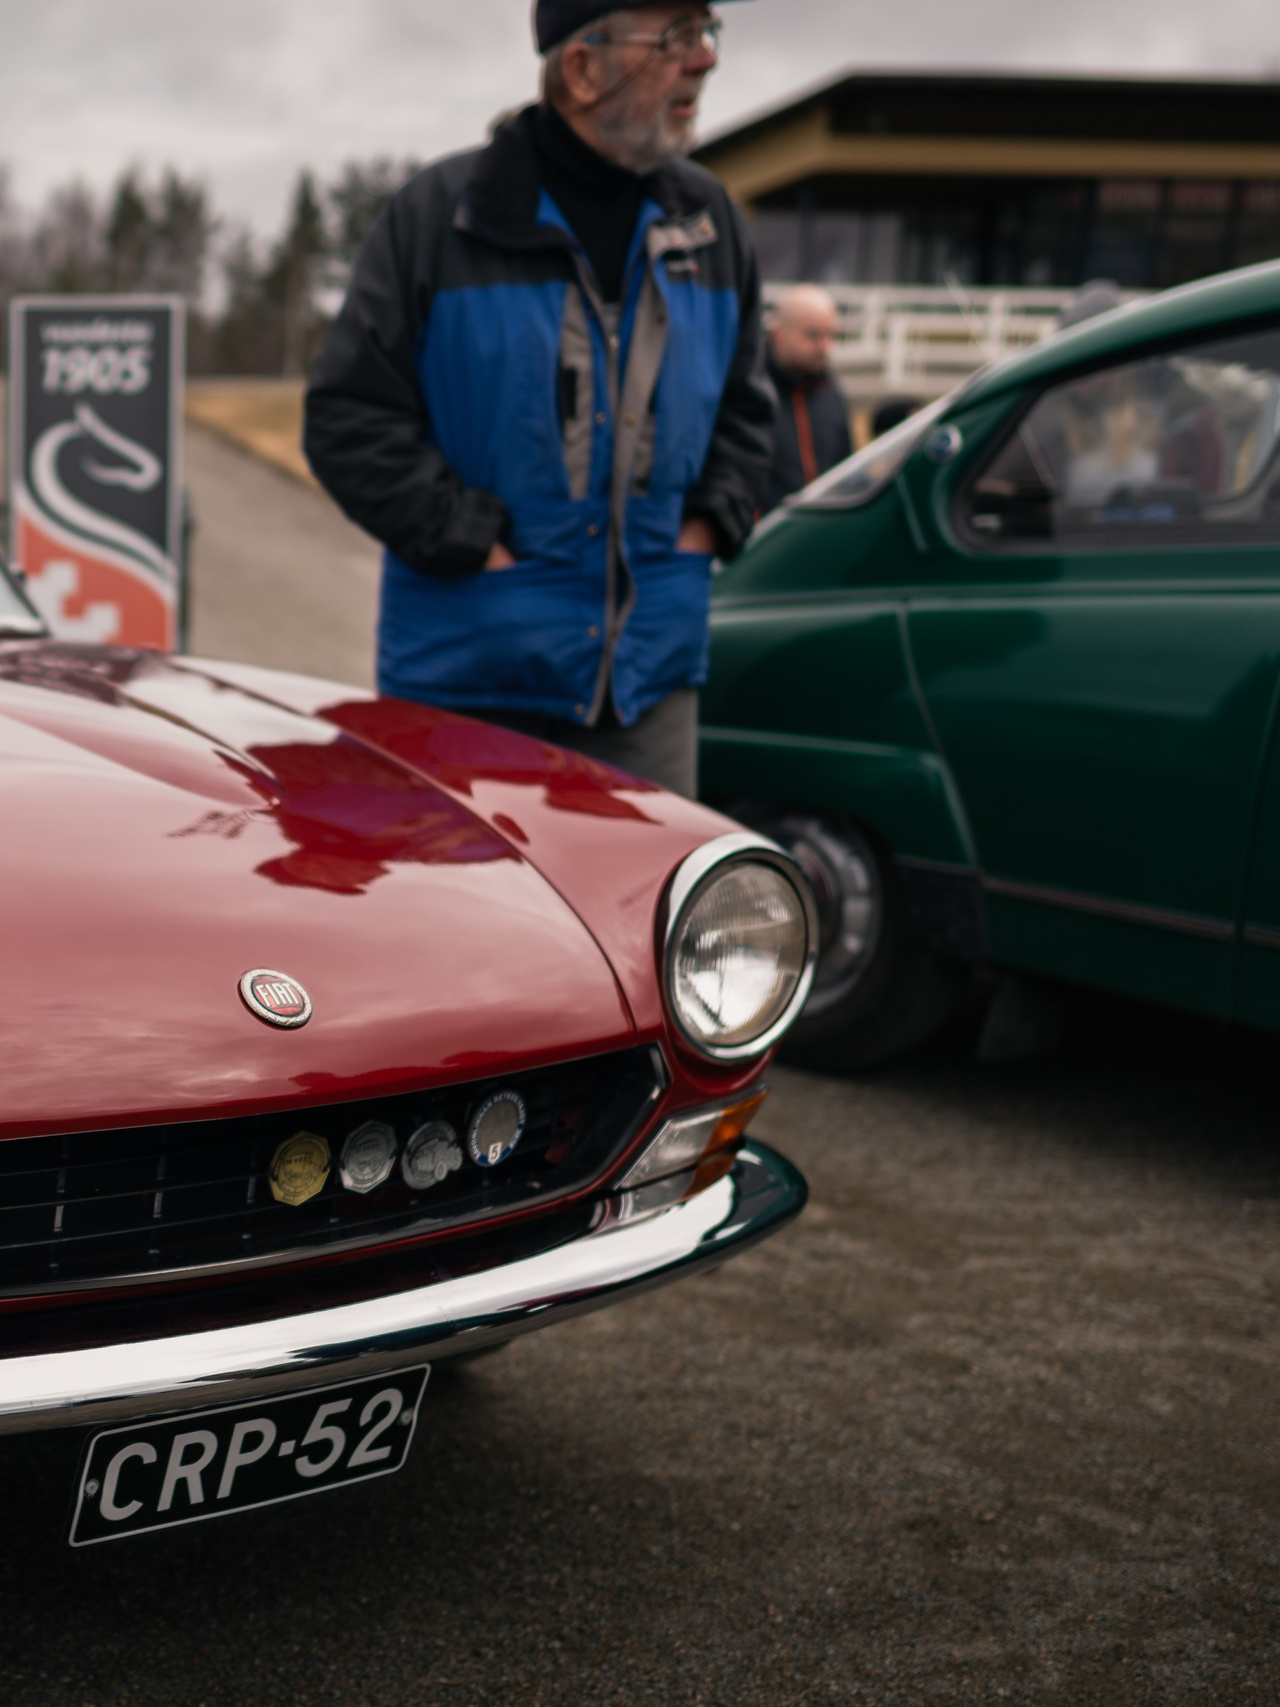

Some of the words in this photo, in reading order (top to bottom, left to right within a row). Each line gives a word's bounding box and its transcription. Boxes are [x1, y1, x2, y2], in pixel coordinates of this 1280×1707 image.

[42, 348, 150, 394] 1905
[255, 982, 299, 1007] FIAT
[490, 1144, 499, 1160] 5
[99, 1388, 403, 1521] CRP-52
